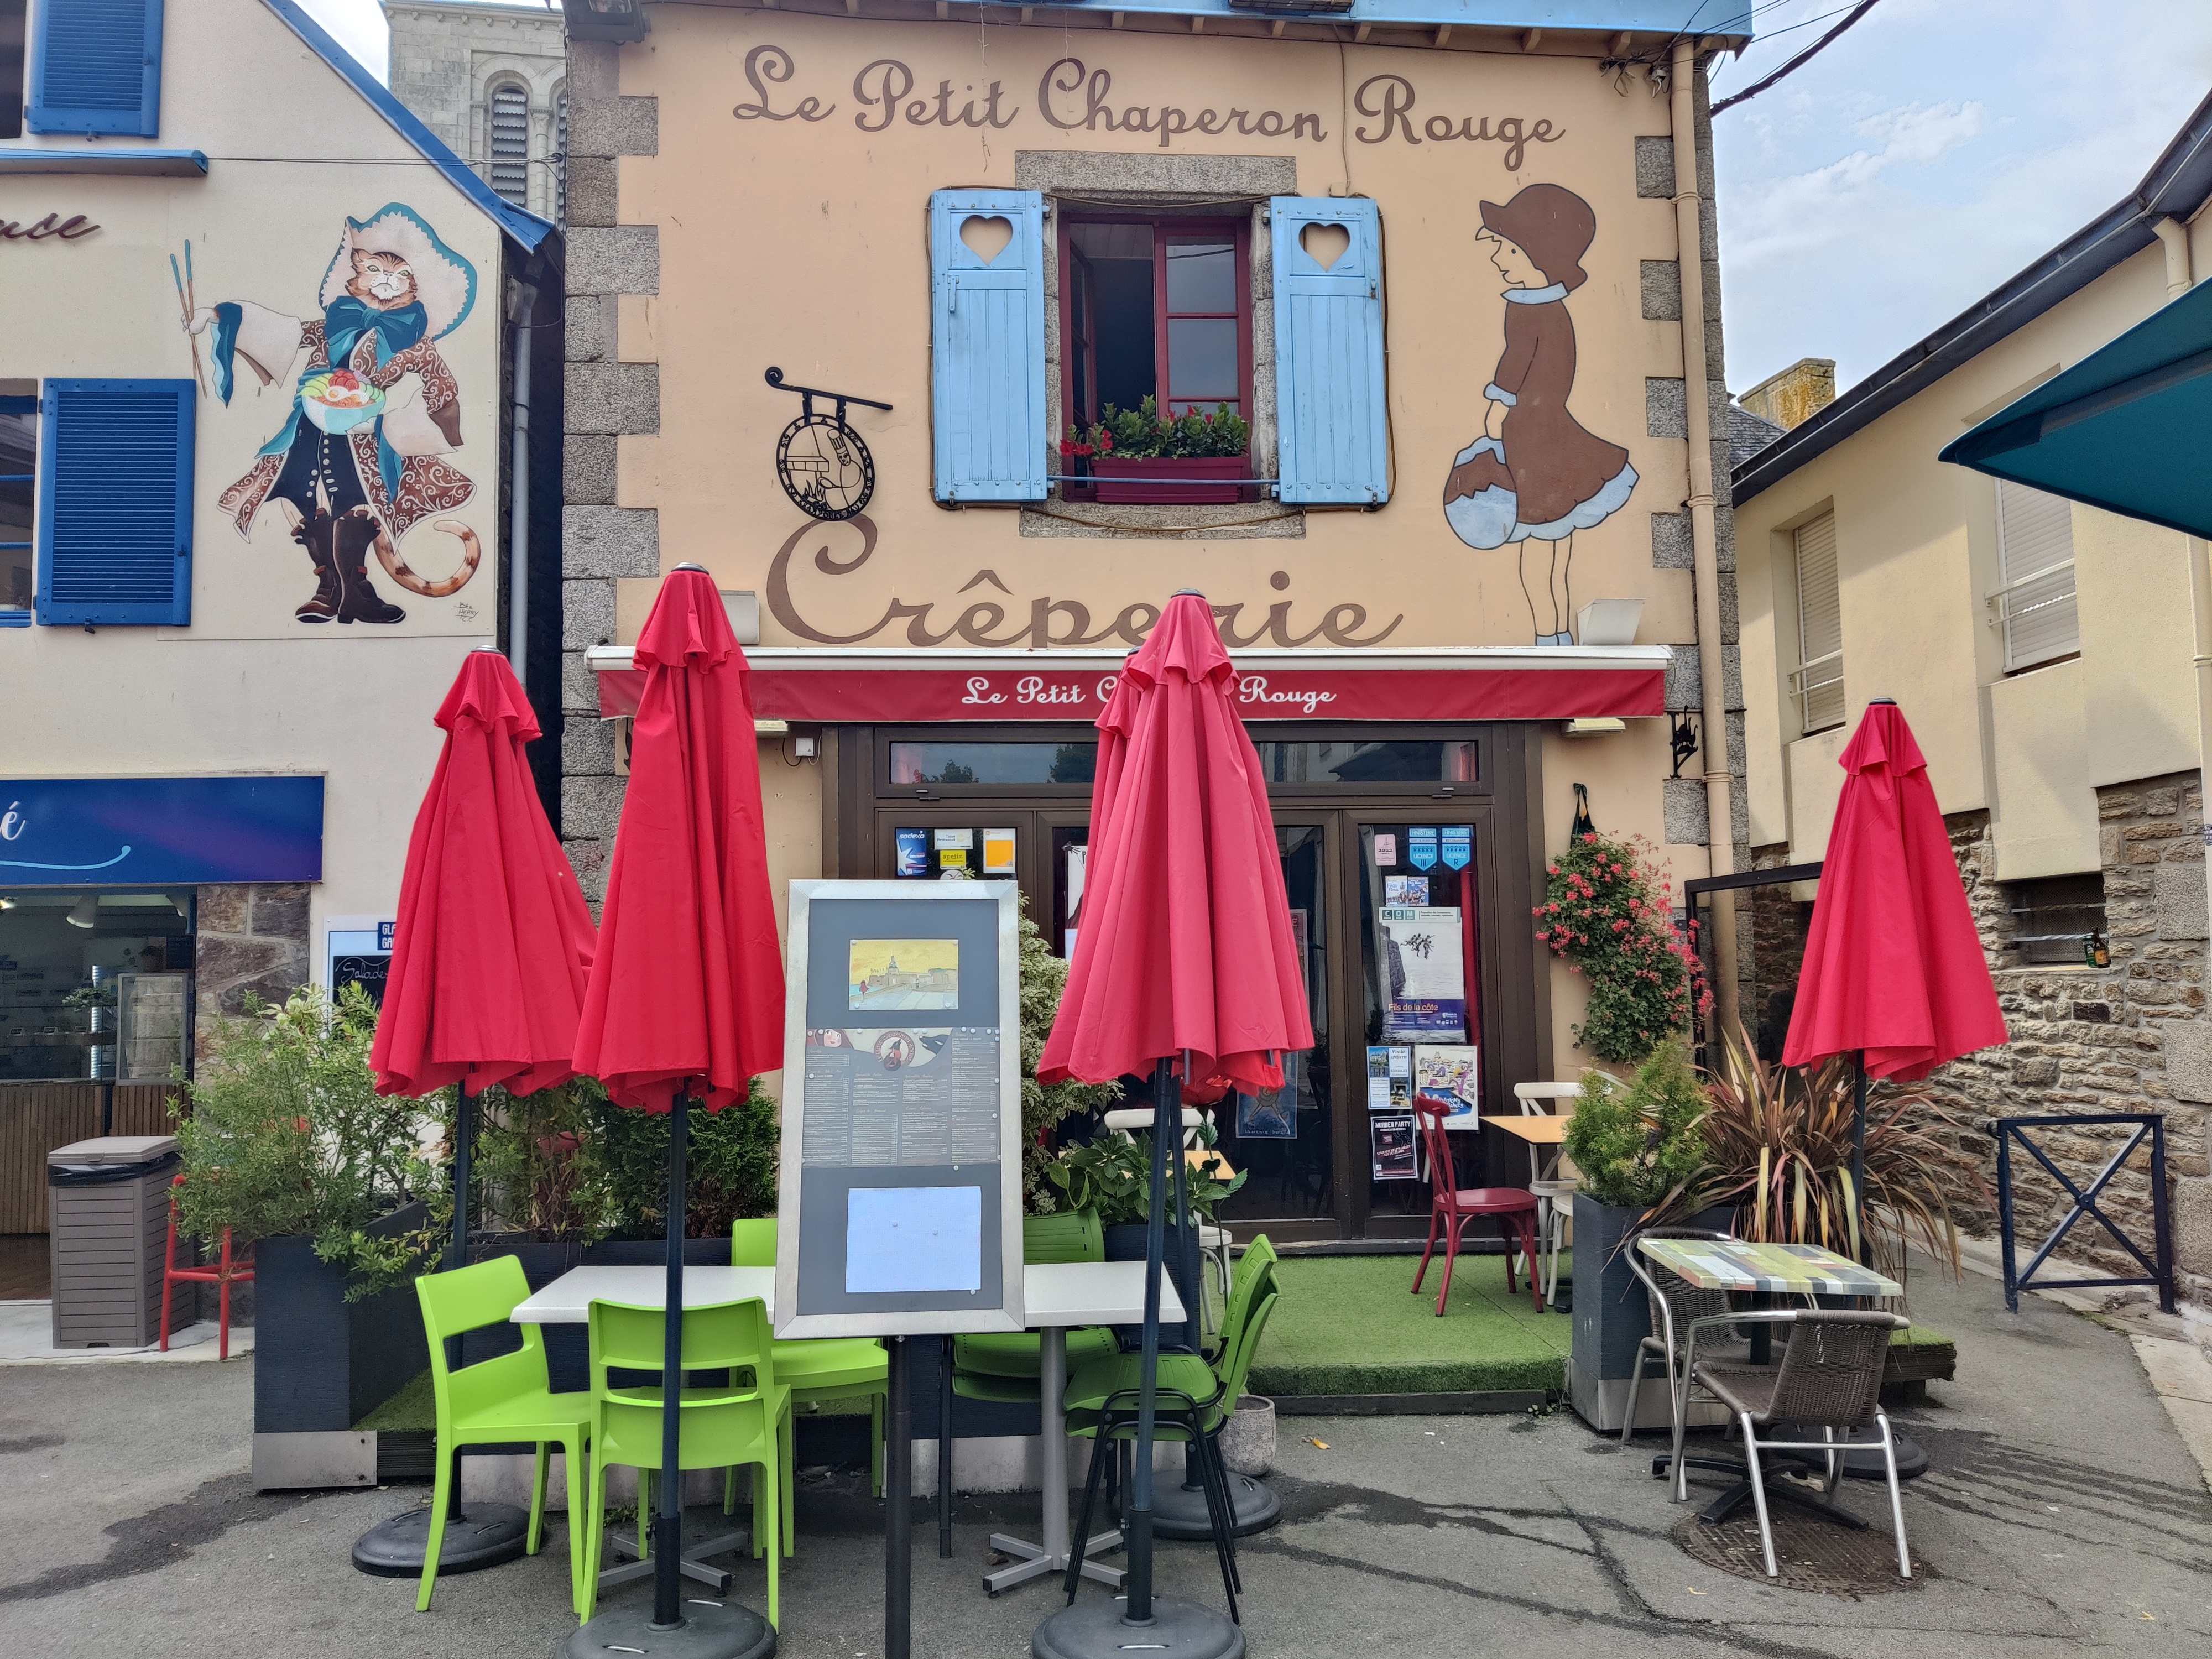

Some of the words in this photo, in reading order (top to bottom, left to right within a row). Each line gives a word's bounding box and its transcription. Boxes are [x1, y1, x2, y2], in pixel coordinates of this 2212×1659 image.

[733, 44, 836, 122] Le
[853, 58, 1020, 132] Petit
[1038, 57, 1328, 148] Chaperon
[1354, 74, 1566, 171] Rouge
[766, 513, 1404, 649] Crêperie
[458, 609, 479, 618] HERRY
[961, 676, 1008, 705] Le
[1016, 676, 1086, 704] Petit
[1239, 676, 1337, 713] Rouge
[1389, 1003, 1401, 1011] Fils
[1422, 1003, 1438, 1011] côte
